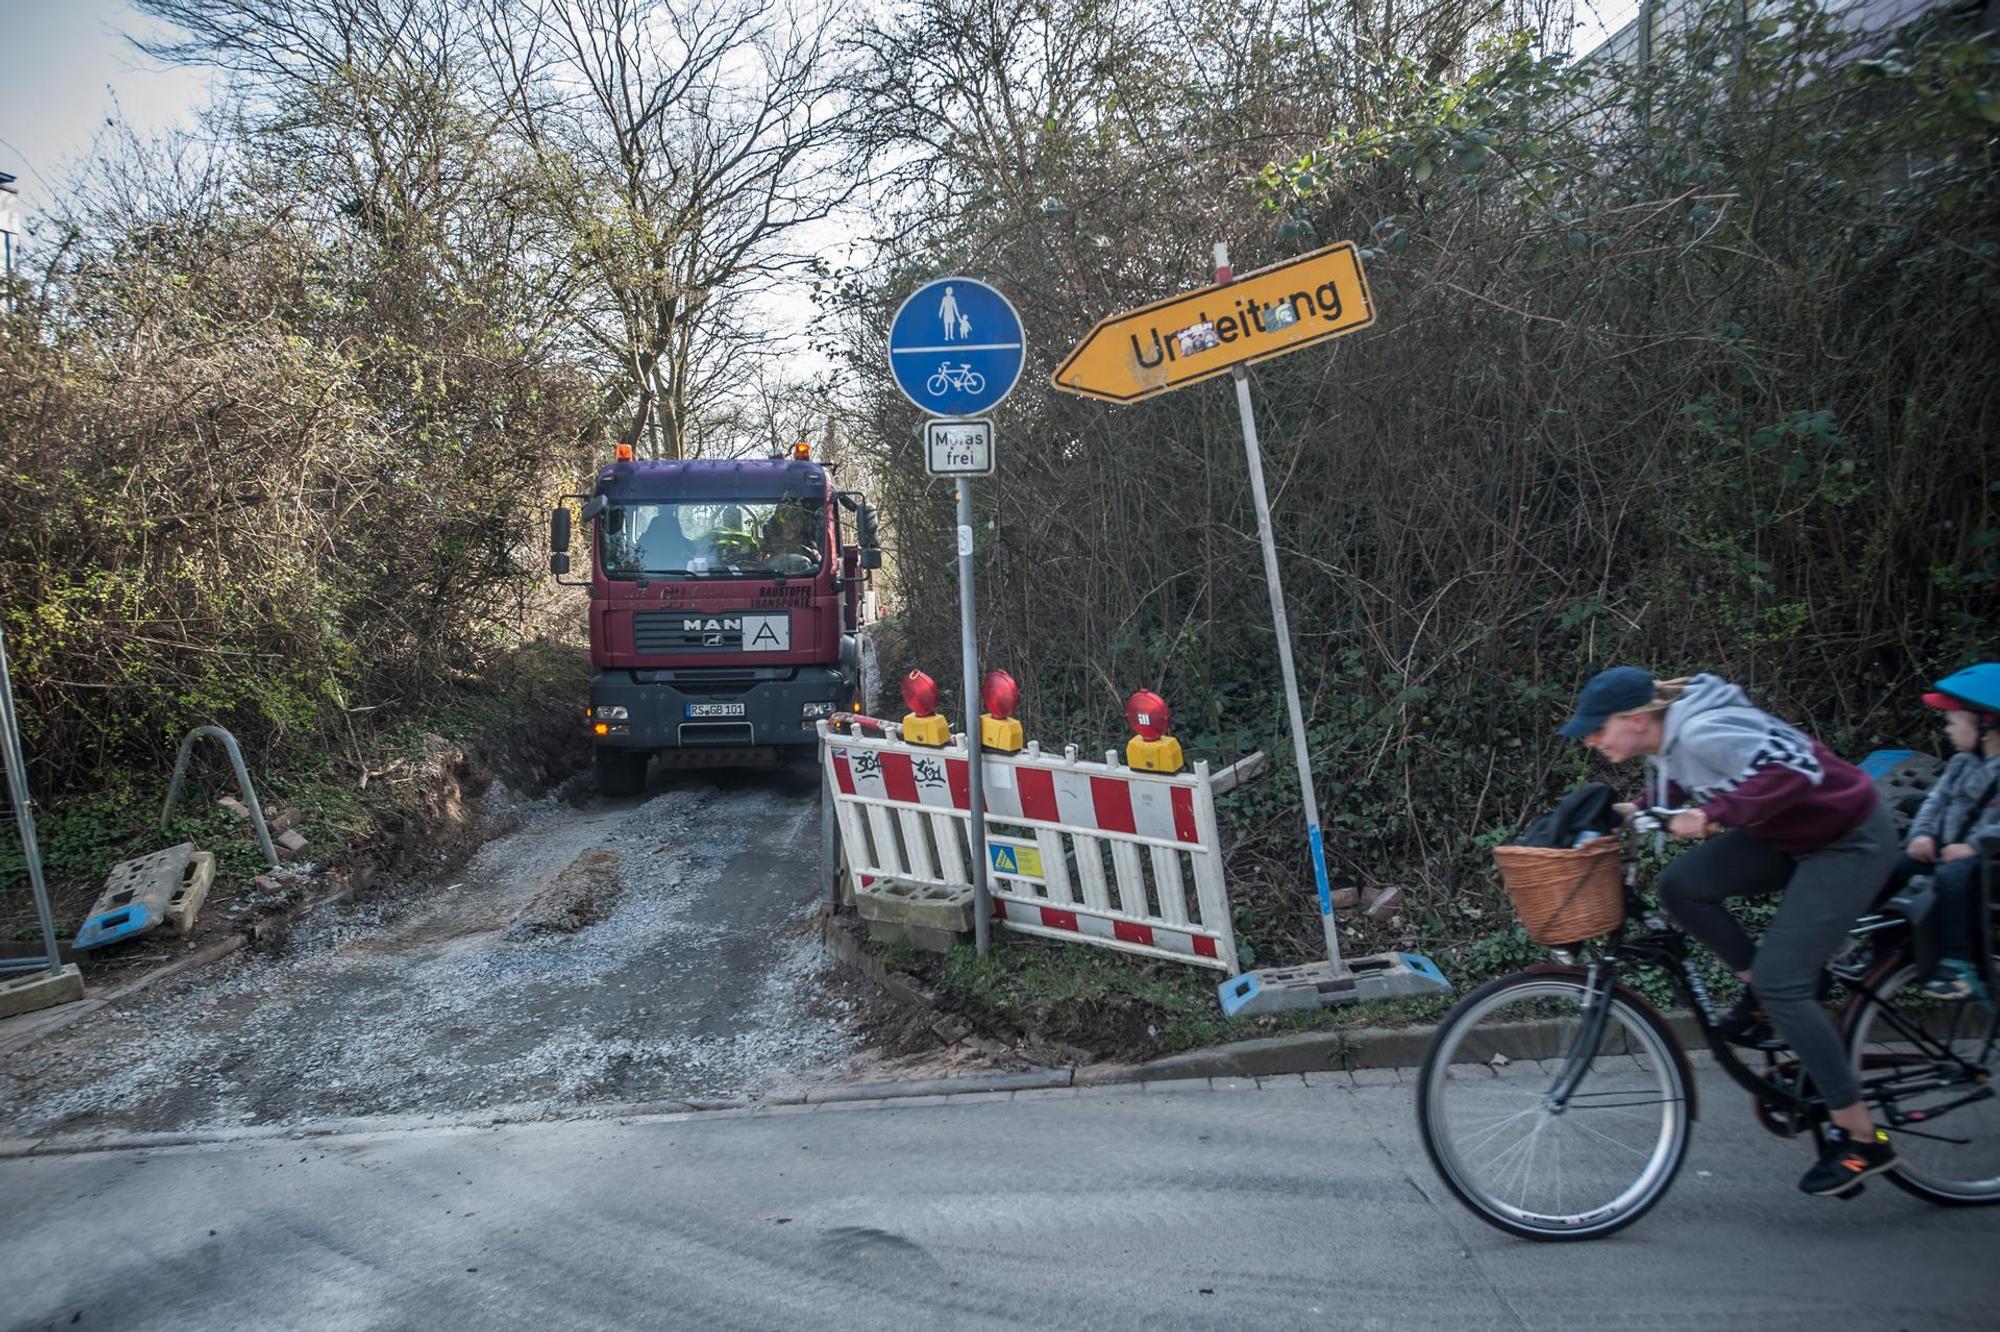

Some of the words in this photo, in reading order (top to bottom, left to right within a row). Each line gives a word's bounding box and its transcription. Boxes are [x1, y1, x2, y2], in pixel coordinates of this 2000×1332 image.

[947, 450, 974, 465] frei
[683, 619, 741, 631] MAN
[752, 622, 781, 646] A
[725, 704, 743, 714] 101
